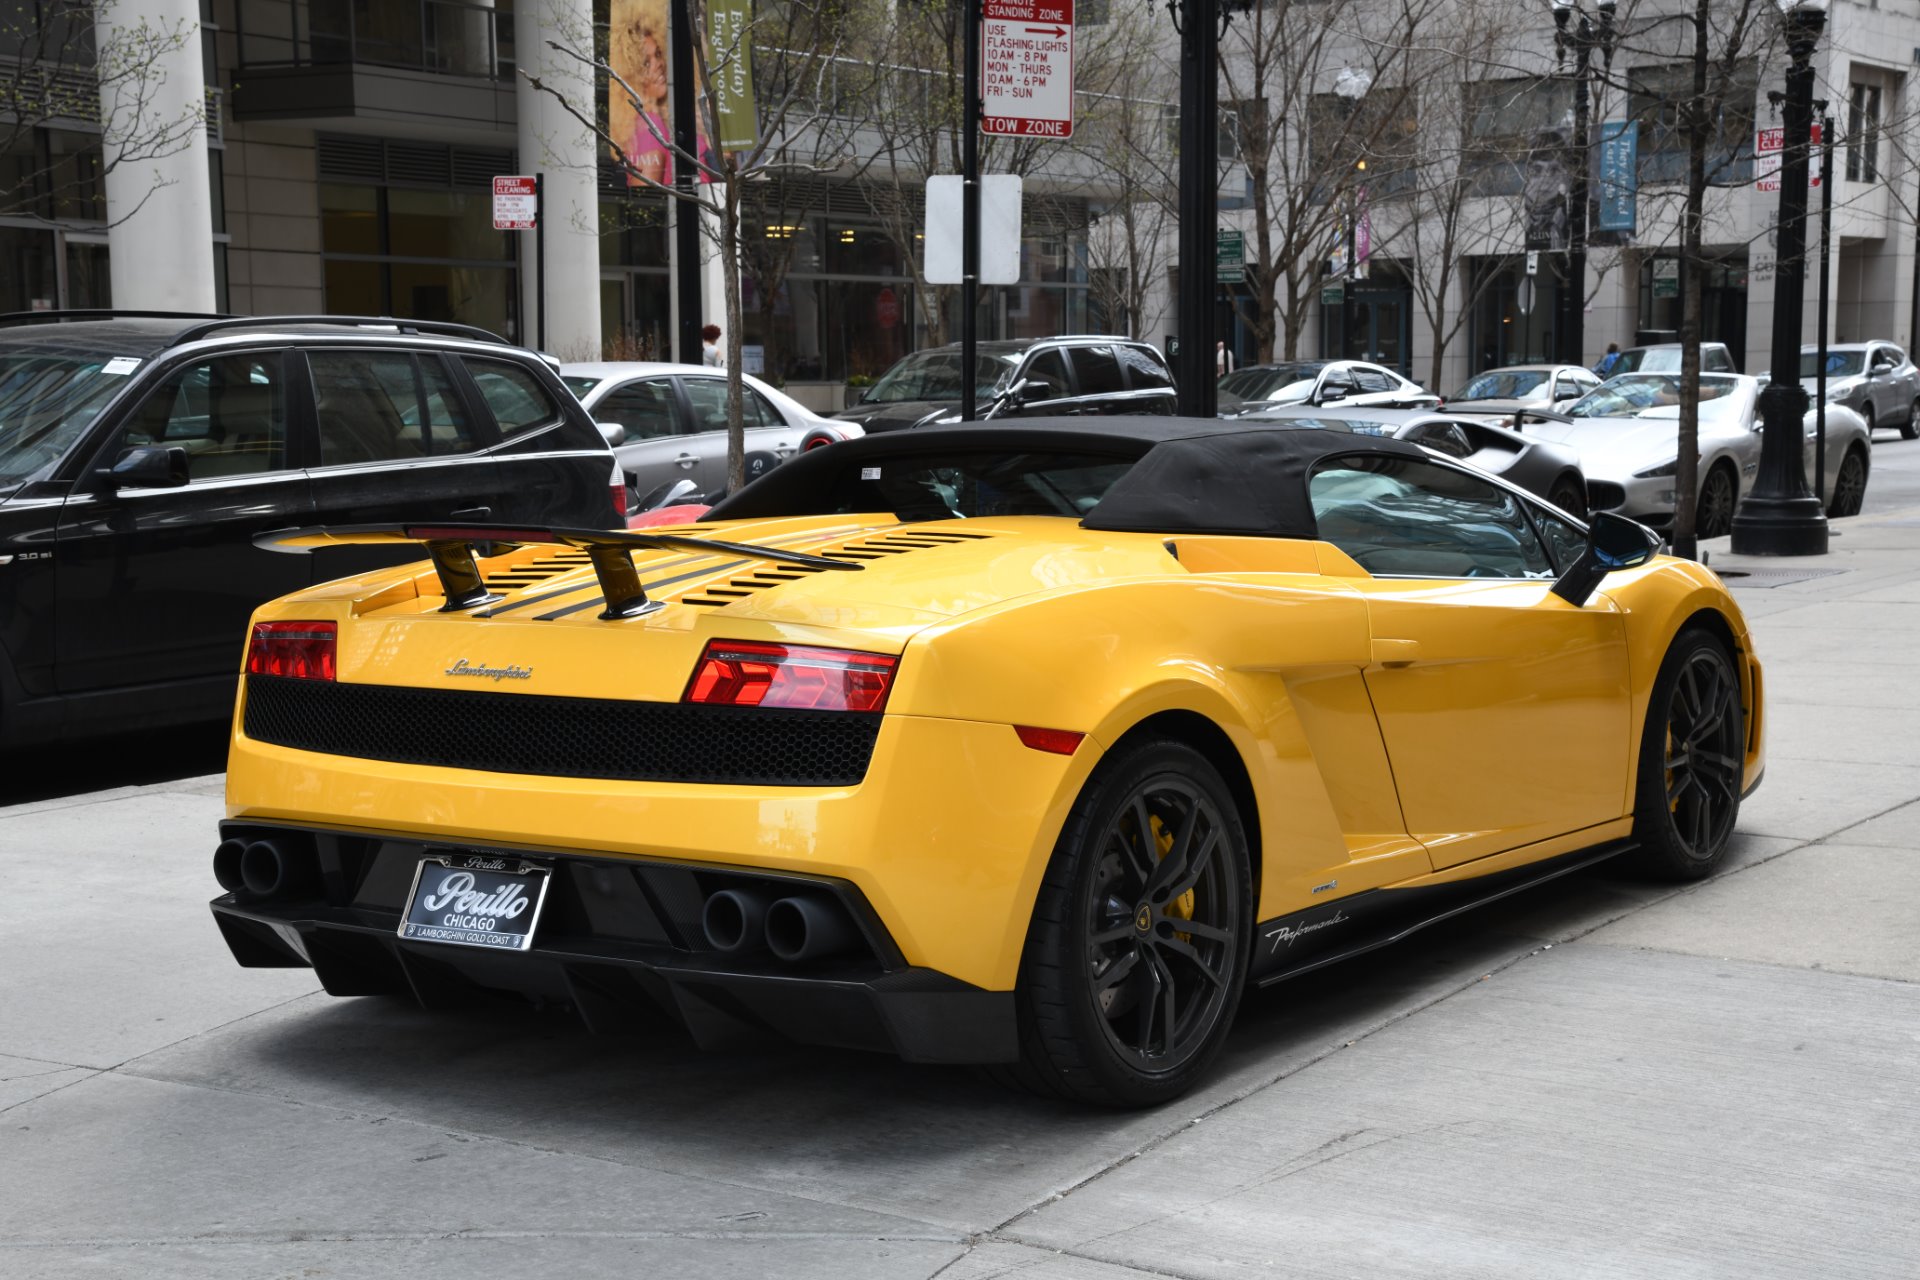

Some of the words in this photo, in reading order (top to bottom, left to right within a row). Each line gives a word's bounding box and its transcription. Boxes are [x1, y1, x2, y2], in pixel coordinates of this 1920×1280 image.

[988, 5, 1034, 19] STANDING
[1039, 9, 1063, 20] ZONE
[987, 25, 1006, 36] USE
[730, 9, 747, 97] Everyday
[987, 37, 1034, 50] FLASHING
[1036, 42, 1068, 53] LIGHTS
[987, 61, 1008, 72] MON
[1020, 63, 1052, 75] THURS
[987, 85, 1002, 96] FRI
[1012, 87, 1033, 98] SUN
[987, 118, 1018, 132] TOW
[1026, 120, 1064, 135] ZONE
[1617, 140, 1631, 169] They
[496, 179, 520, 187] STREET
[497, 220, 510, 228] TOW
[514, 220, 532, 228] ZONE
[445, 658, 533, 681] Lamborghini
[464, 856, 506, 870] Perillo
[424, 872, 529, 919] Perillo
[443, 914, 496, 931] CHICAGO
[417, 928, 467, 941] LAMBORGHINI
[467, 933, 486, 943] GOLD
[487, 934, 510, 945] COAST
[1265, 910, 1349, 954] Performante
